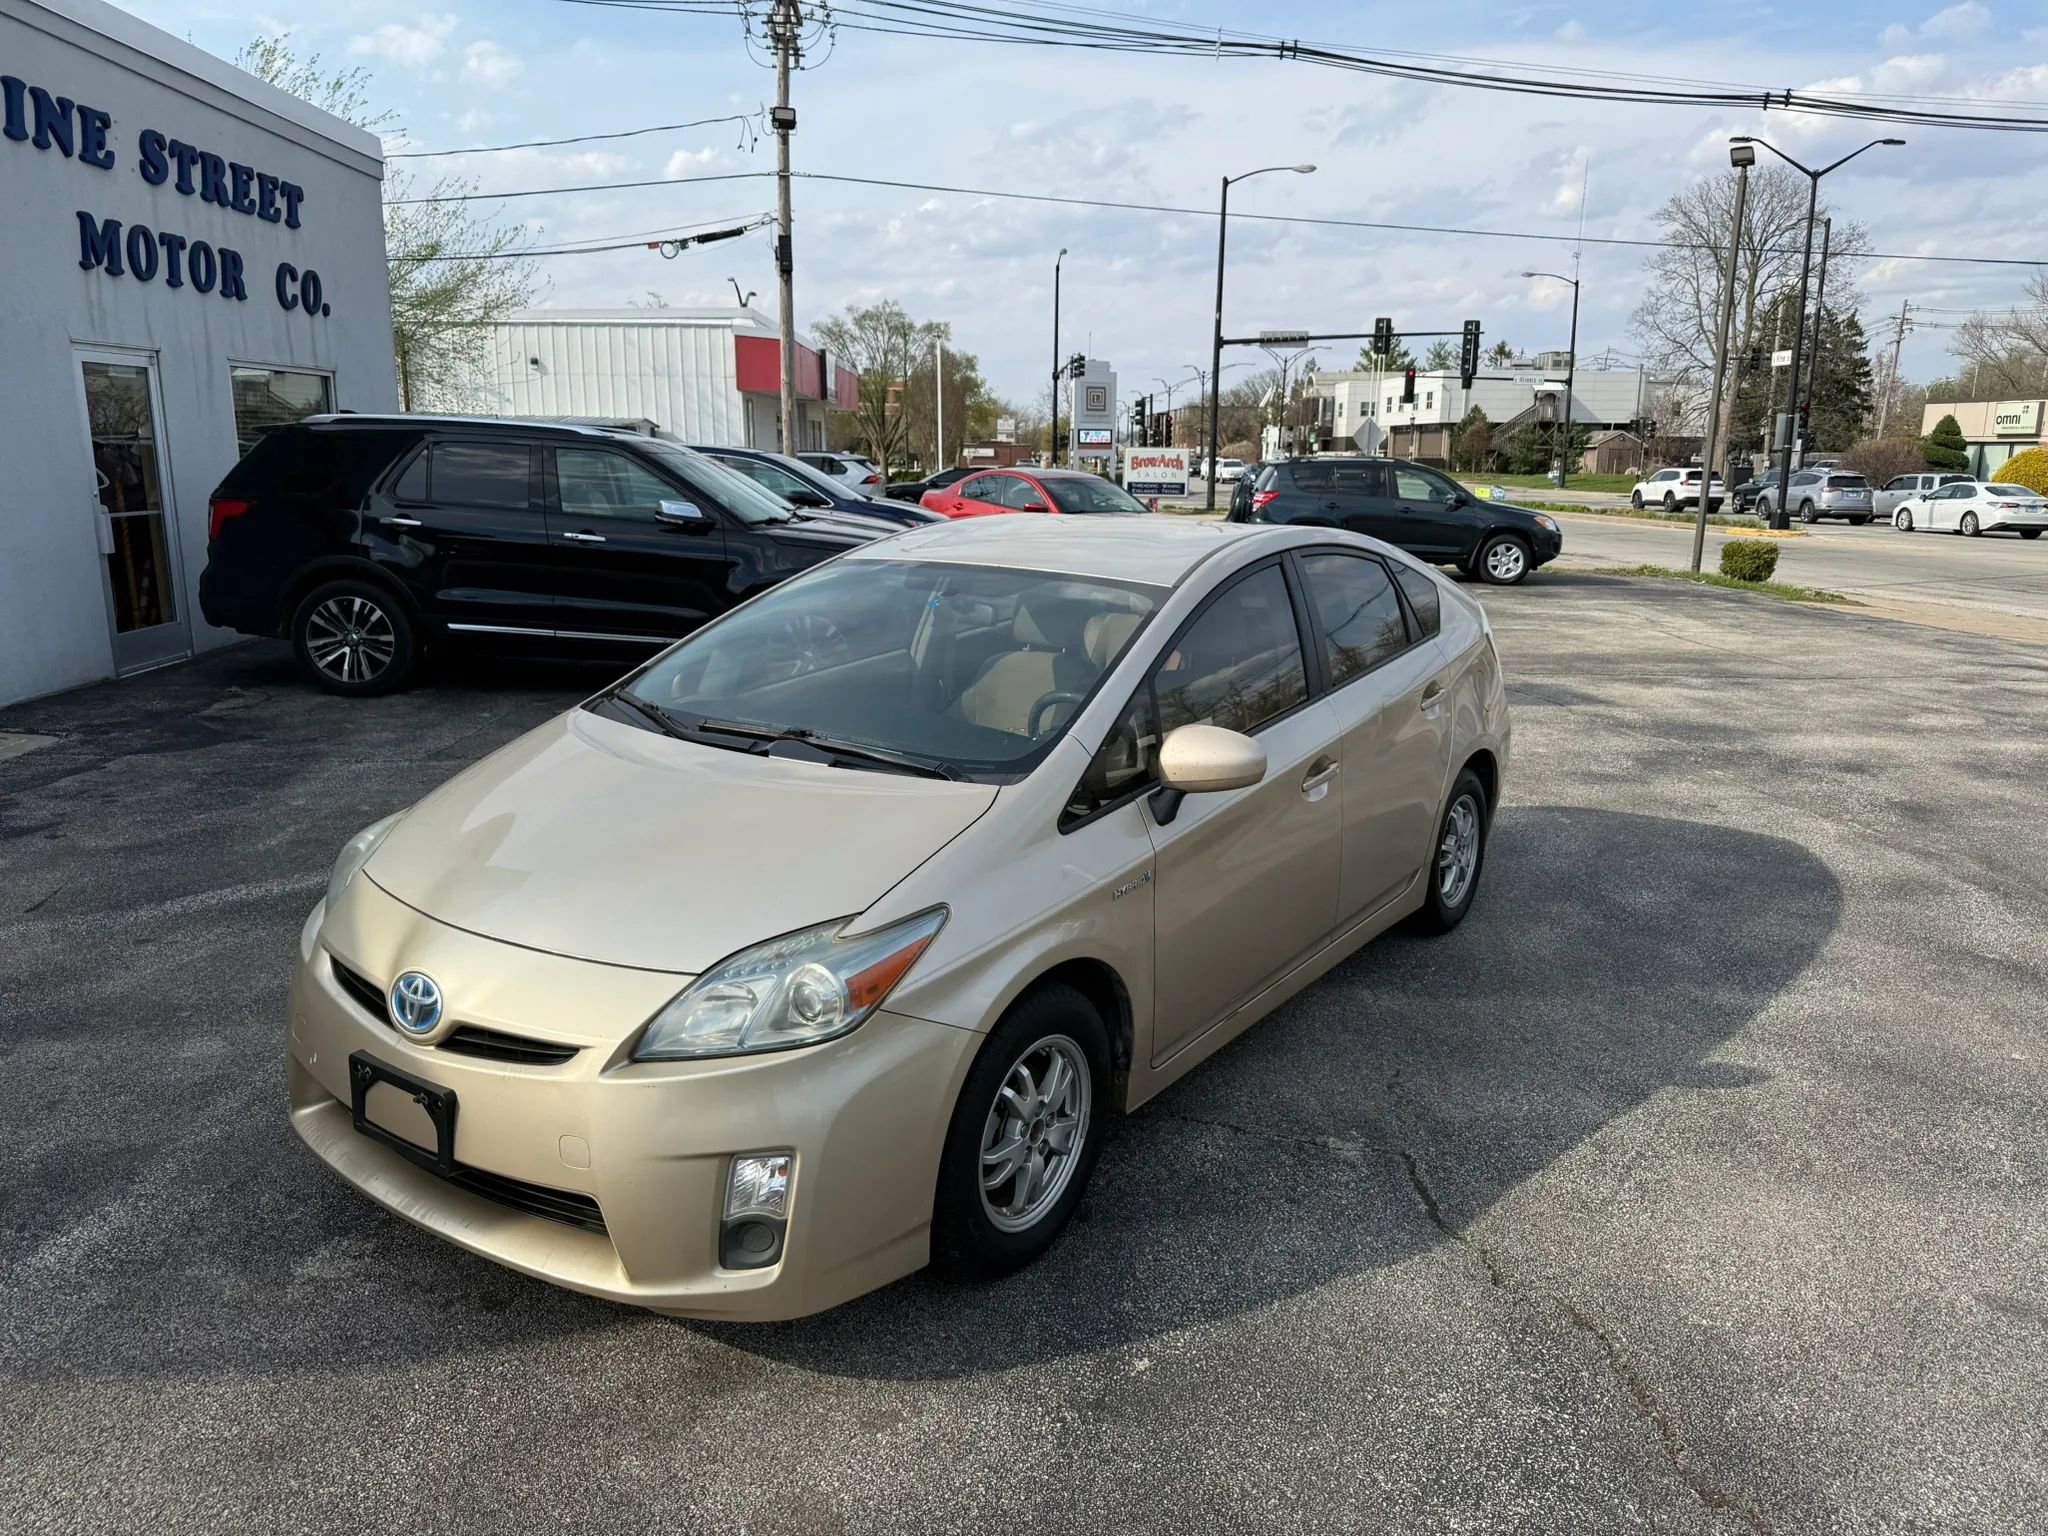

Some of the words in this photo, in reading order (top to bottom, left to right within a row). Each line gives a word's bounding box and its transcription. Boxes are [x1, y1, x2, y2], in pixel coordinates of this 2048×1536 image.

[139, 129, 304, 229] STREET
[76, 210, 248, 301] MOTOR
[275, 262, 330, 317] CO.
[1996, 414, 2021, 425] omni
